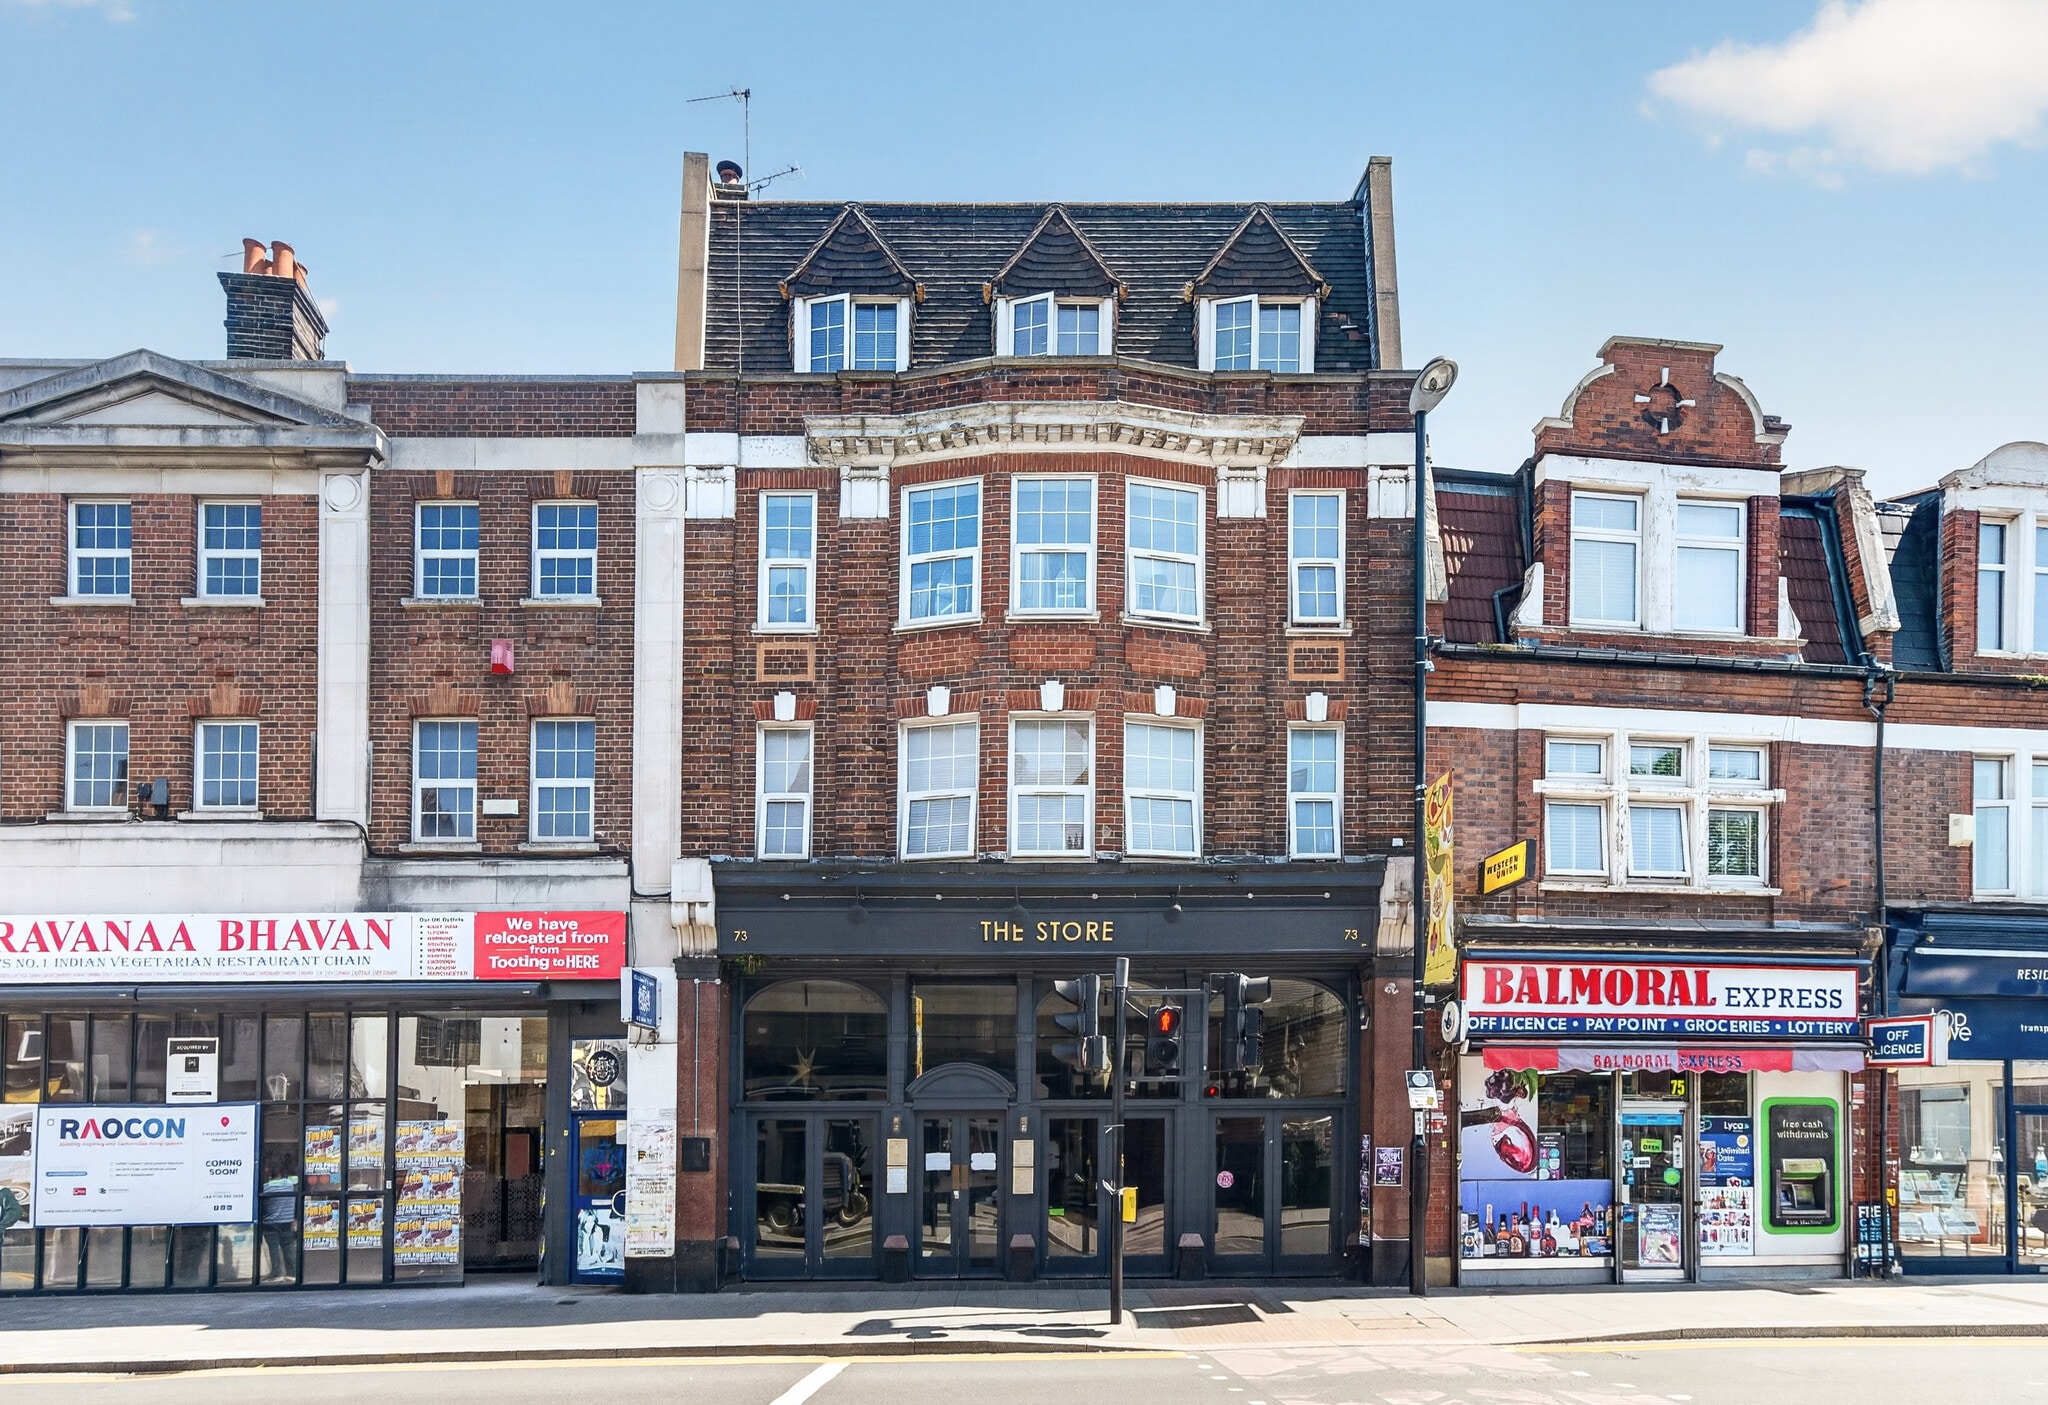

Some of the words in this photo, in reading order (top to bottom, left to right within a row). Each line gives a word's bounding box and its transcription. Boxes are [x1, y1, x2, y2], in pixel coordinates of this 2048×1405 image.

[1497, 864, 1518, 879] UNION
[506, 917, 533, 931] We
[538, 917, 578, 931] have
[217, 919, 394, 951] BHAVAN
[485, 931, 567, 945] relocated
[571, 932, 609, 944] from
[734, 930, 747, 941] 73
[980, 921, 1024, 942] THE
[1036, 921, 1114, 942] STORE
[1344, 929, 1358, 940] 73
[530, 945, 559, 954] from
[54, 957, 106, 968] INDIAN
[110, 956, 212, 968] VEGETARIAN
[217, 956, 320, 967] RESTAURANT
[324, 955, 371, 967] CHAIN
[489, 956, 549, 970] Tooting
[553, 958, 565, 967] to
[566, 955, 600, 969] HERE
[1483, 967, 1717, 1006] BALMORAL
[1725, 987, 1843, 1009] EXPRESS
[1468, 1017, 1497, 1030] OFF
[1501, 1017, 1567, 1031] LICENCE
[1586, 1018, 1614, 1031] PAY
[1618, 1018, 1667, 1031] POINT
[1685, 1019, 1770, 1033] GROCERIES
[1788, 1020, 1853, 1034] LOTTERY
[1886, 1030, 1909, 1041] OFF
[1874, 1043, 1922, 1055] LICENCE
[1594, 1055, 1672, 1068] BALMORAL
[1680, 1056, 1742, 1068] EXPRESS
[1670, 1079, 1685, 1096] 75
[1723, 1121, 1744, 1131] Lyca
[1802, 1119, 1823, 1128] cash
[1776, 1130, 1829, 1139] withdrawals
[205, 1159, 243, 1167] COMING
